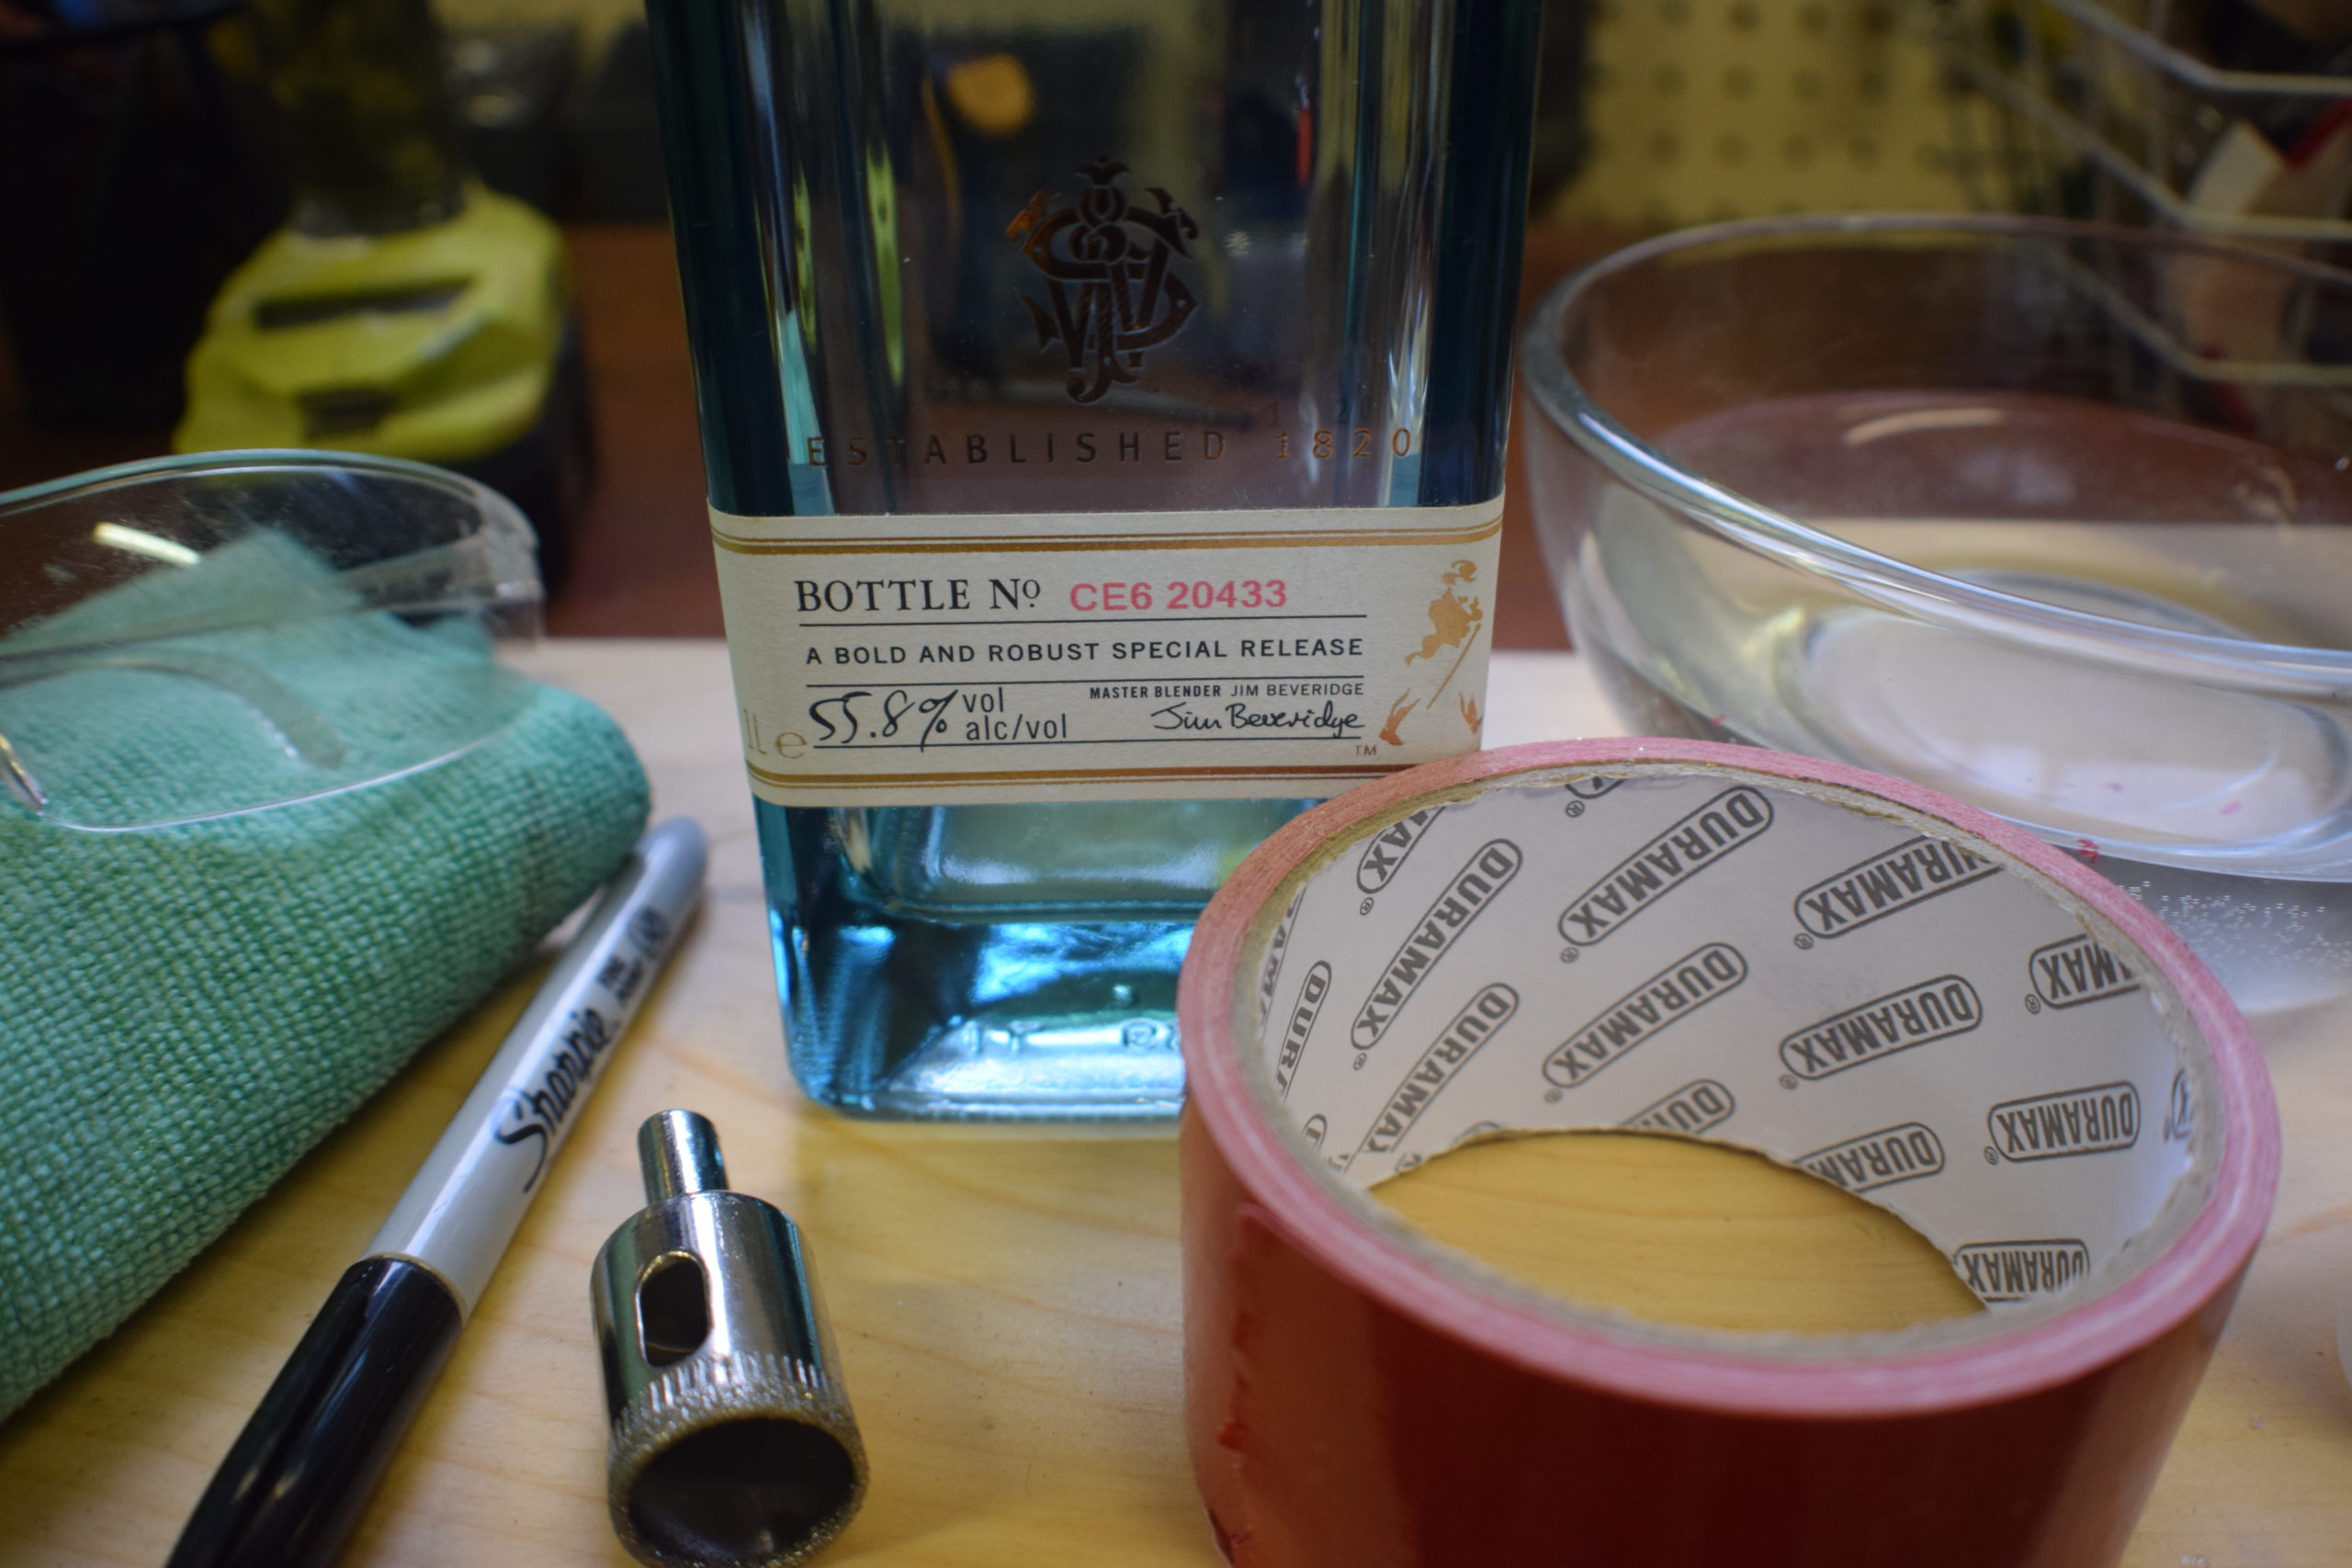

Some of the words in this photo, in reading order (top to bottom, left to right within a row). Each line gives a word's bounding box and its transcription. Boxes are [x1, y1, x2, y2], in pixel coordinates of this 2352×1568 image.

[806, 432, 1225, 467] ESTABLISHED
[1274, 427, 1411, 458] 1820
[795, 580, 971, 612] BOTTLE
[1069, 581, 1153, 611] CE6
[1166, 580, 1287, 610] 20433
[806, 647, 822, 665] A
[835, 646, 907, 665] BOLD
[919, 645, 976, 663] AND
[989, 643, 1100, 662] ROBUST
[1112, 640, 1227, 660] SPECIAL
[1241, 638, 1363, 658] RELEASE
[1090, 685, 1148, 699] MASTER
[1154, 684, 1222, 698] BLENDER
[1230, 683, 1259, 697] JIM
[1266, 682, 1364, 696] BEVERIDGE
[808, 689, 958, 753] 55.8%
[962, 687, 1005, 714] vol
[966, 713, 1068, 741] alc/vol
[1150, 702, 1222, 730] Jim
[1225, 700, 1365, 739] Beveridge
[1354, 744, 1377, 757] TM
[1566, 793, 1766, 939] DURAMAX
[1804, 840, 1991, 931] URAMAX
[1356, 847, 1515, 1037] DURAMAX
[1552, 949, 1739, 1081] DURAMAX
[1788, 983, 1974, 1074] DURAMAX
[1996, 1091, 2134, 1154] DURAMAX
[1961, 1249, 2085, 1293] DURAMAX
